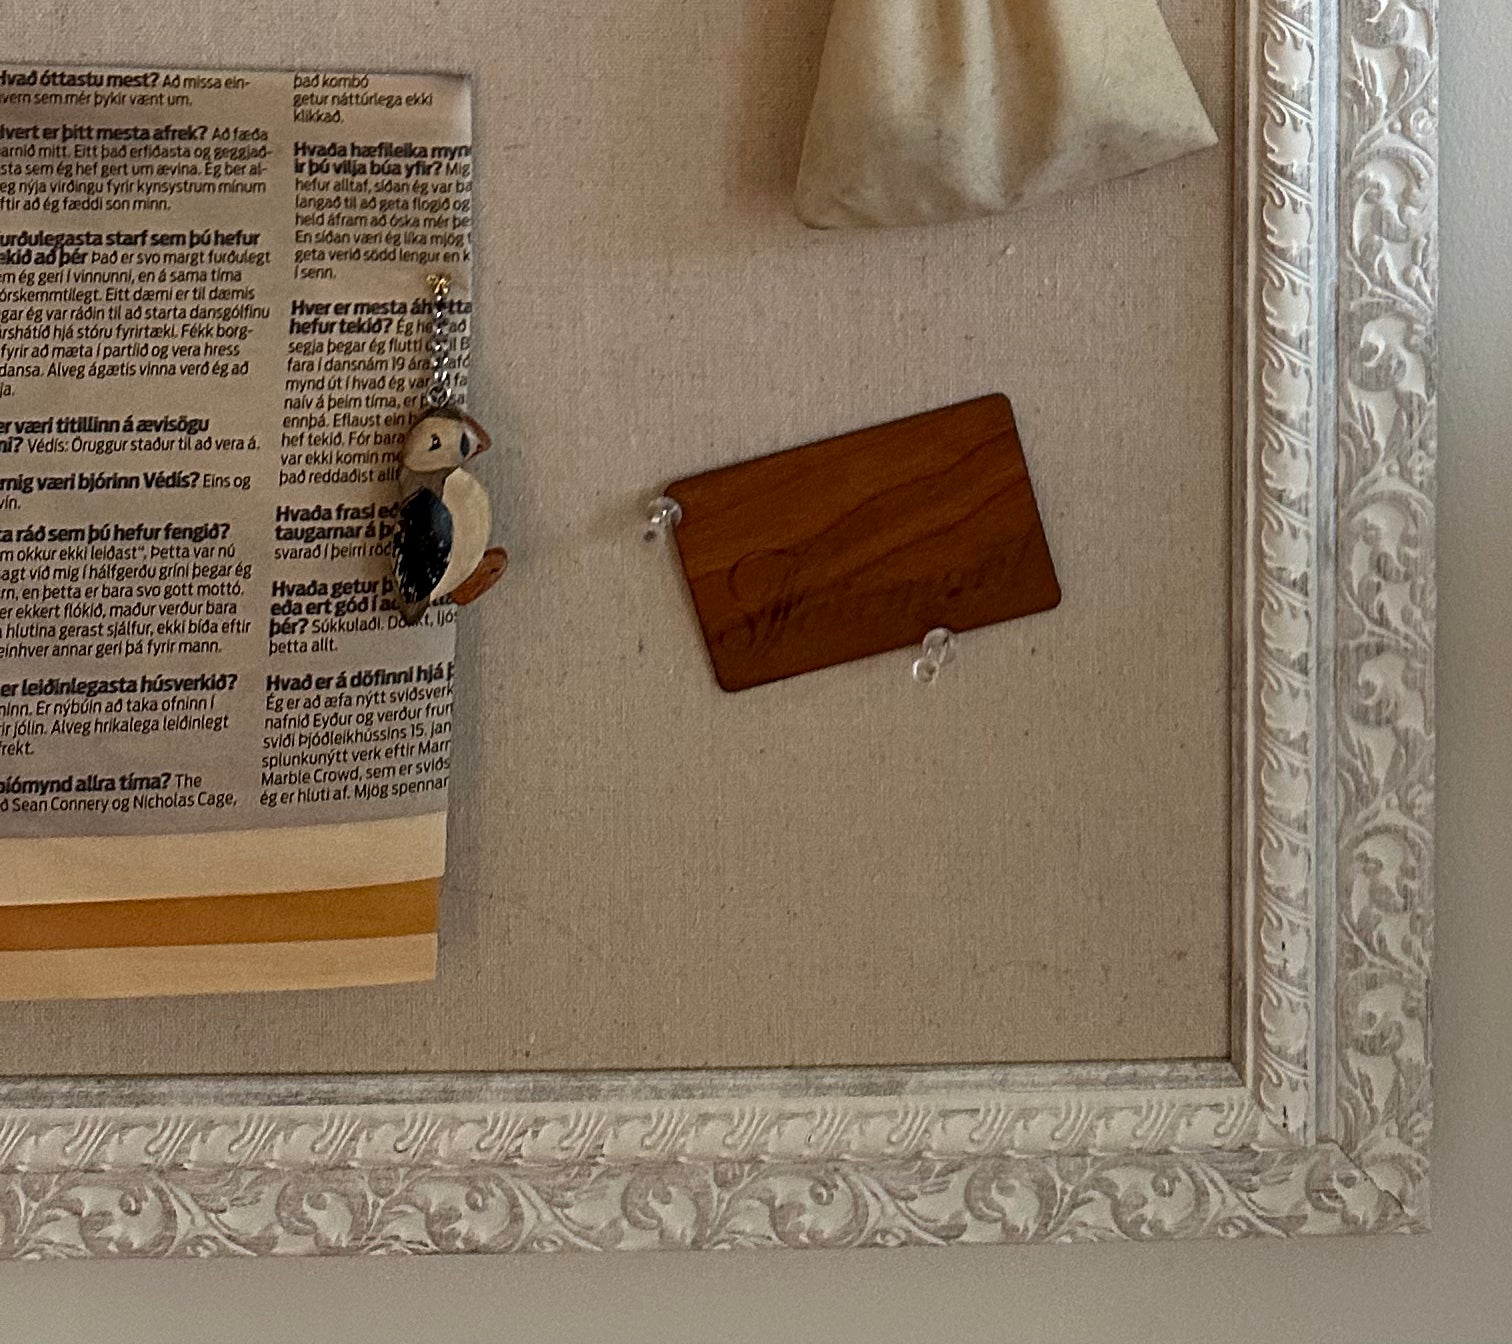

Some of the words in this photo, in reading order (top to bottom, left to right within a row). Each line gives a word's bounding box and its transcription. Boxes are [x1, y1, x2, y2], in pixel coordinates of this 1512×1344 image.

[40, 70, 104, 88] óttastu
[106, 72, 160, 88] mest?
[162, 74, 180, 88] Að
[183, 75, 222, 89] missa
[224, 76, 251, 89] ein-
[293, 73, 320, 91] það
[322, 73, 369, 89] kombó
[33, 93, 62, 104] sem
[65, 90, 91, 105] mér
[94, 90, 126, 108] þykir
[130, 92, 163, 106] vænt
[167, 94, 192, 106] um.
[293, 94, 330, 108] getur
[332, 91, 403, 108] náttúrlega
[406, 92, 433, 106] ekki
[293, 141, 347, 158] Hvaða
[106, 229, 148, 246] starf
[150, 233, 186, 246] sem
[190, 228, 211, 248] þú
[214, 229, 261, 246] hefur
[14, 416, 54, 434] væri
[57, 415, 120, 434] titillinn
[122, 415, 134, 433] á
[136, 415, 210, 435] ævisögu
[27, 438, 69, 453] Védís:
[71, 437, 128, 455] Öruggur
[130, 436, 175, 452] staður
[178, 436, 192, 451] til
[194, 436, 213, 450] að
[215, 439, 244, 450] vera
[247, 435, 261, 450] á.
[36, 473, 76, 490] væri
[78, 471, 140, 493] bjórinn
[143, 471, 200, 490] Védís?
[203, 473, 231, 489] Eins
[233, 475, 251, 490] og
[275, 505, 333, 522] Hvaða
[335, 503, 376, 520] frasi
[16, 524, 46, 543] ráð
[47, 526, 85, 542] sem
[88, 524, 110, 545] þú
[113, 523, 161, 542] hefur
[164, 523, 231, 543] fengið?
[274, 524, 361, 543] taugarnar
[269, 618, 309, 638] þér?
[311, 616, 384, 634] Súkkulaði.
[269, 638, 308, 656] þetta
[311, 637, 338, 653] allt.
[21, 676, 138, 697] leiðinlegasta
[140, 674, 238, 693] húsverkið?
[266, 673, 313, 691] Hvað
[315, 674, 335, 689] er
[336, 670, 348, 688] á
[416, 662, 444, 682] hjá
[51, 718, 91, 736] Alveg
[94, 716, 159, 735] hrikalega
[163, 714, 229, 733] leiðinlegt
[263, 733, 295, 749] sviði
[410, 722, 428, 740] 15.
[262, 747, 347, 769] splunkunýtt
[351, 745, 382, 762] verk
[384, 740, 416, 758] eftir
[75, 774, 116, 793] allra
[119, 772, 171, 792] tíma?
[175, 773, 202, 789] The
[261, 769, 311, 787] Marble
[313, 765, 363, 783] Crowd,
[365, 765, 396, 780] sem
[398, 763, 414, 778] er
[12, 797, 48, 812] Sean
[51, 796, 109, 814] Connery
[112, 798, 130, 812] og
[133, 792, 195, 810] Nicholas
[197, 792, 238, 808] Cage,
